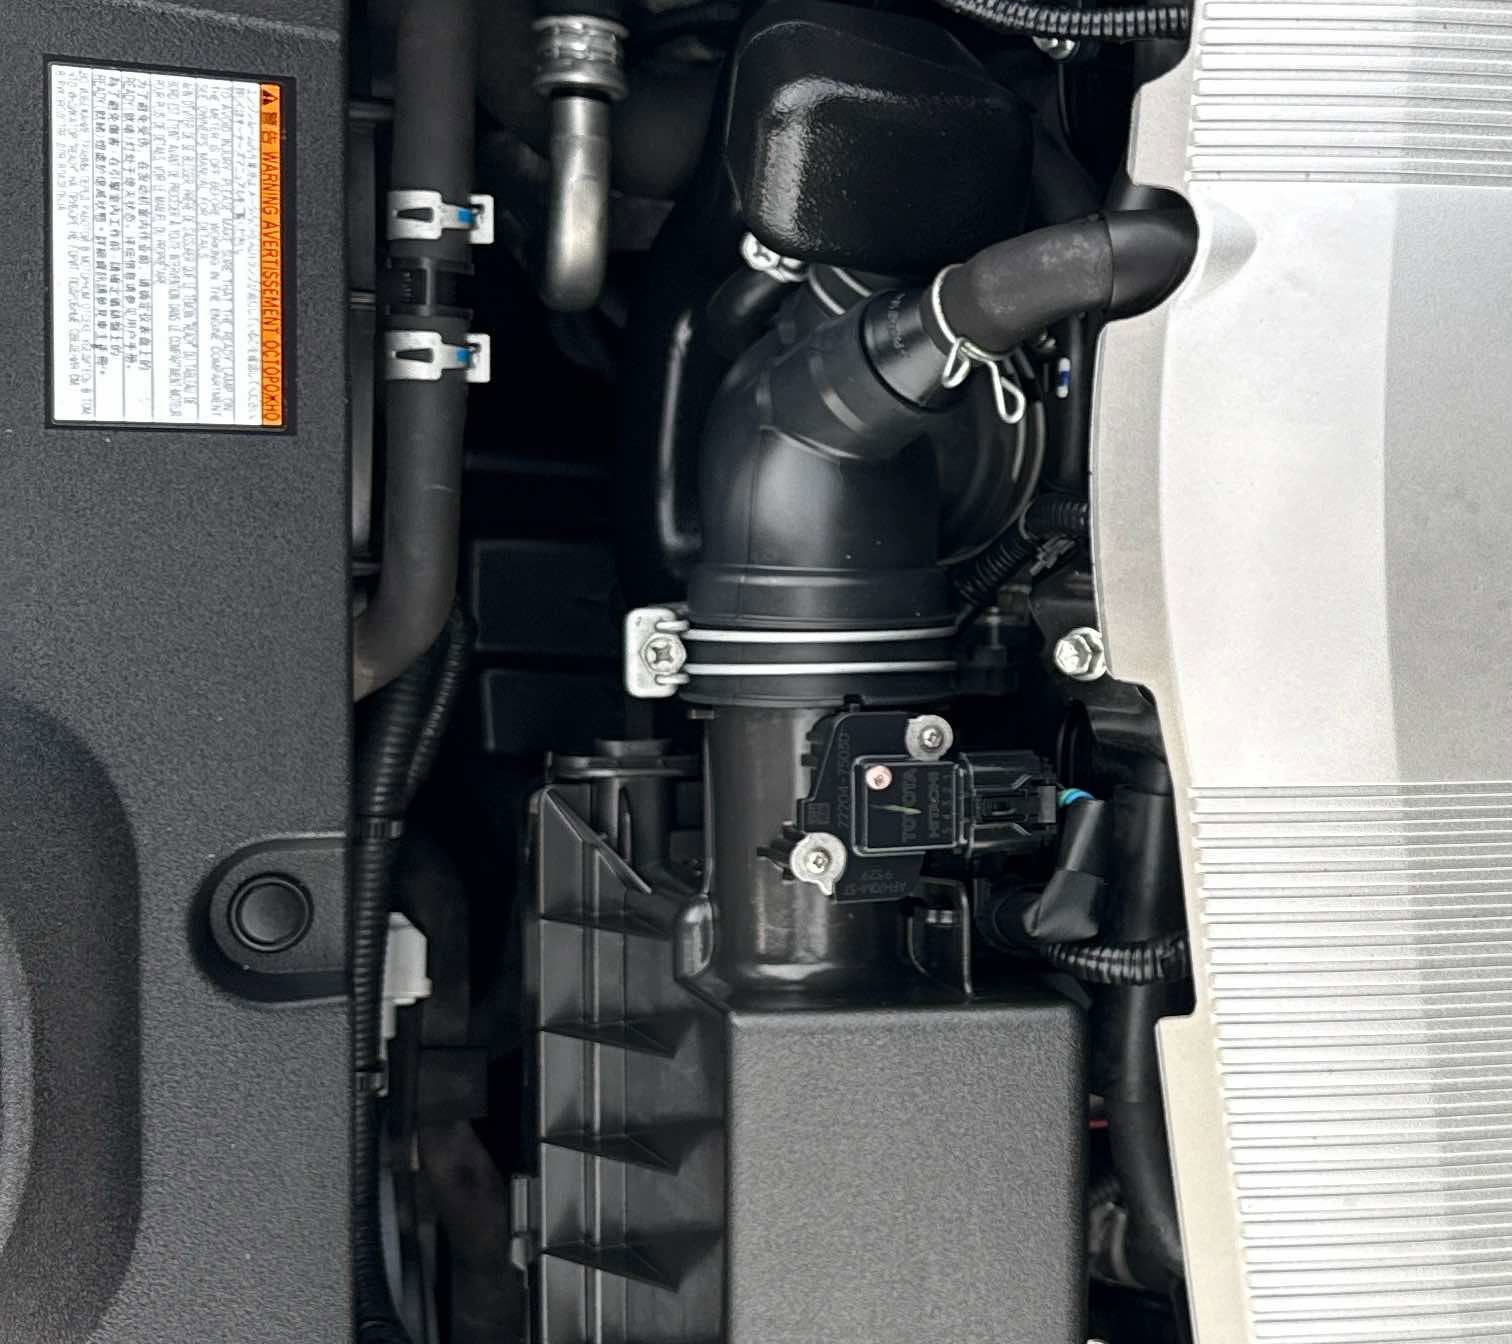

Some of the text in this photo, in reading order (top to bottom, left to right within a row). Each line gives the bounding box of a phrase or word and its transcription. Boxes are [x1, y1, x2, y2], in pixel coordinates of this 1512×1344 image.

[262, 151, 279, 335] WARNING AVERTISSEMENT
[263, 340, 281, 421] ОСТОРОЖНО
[902, 768, 918, 842] TOYOTA
